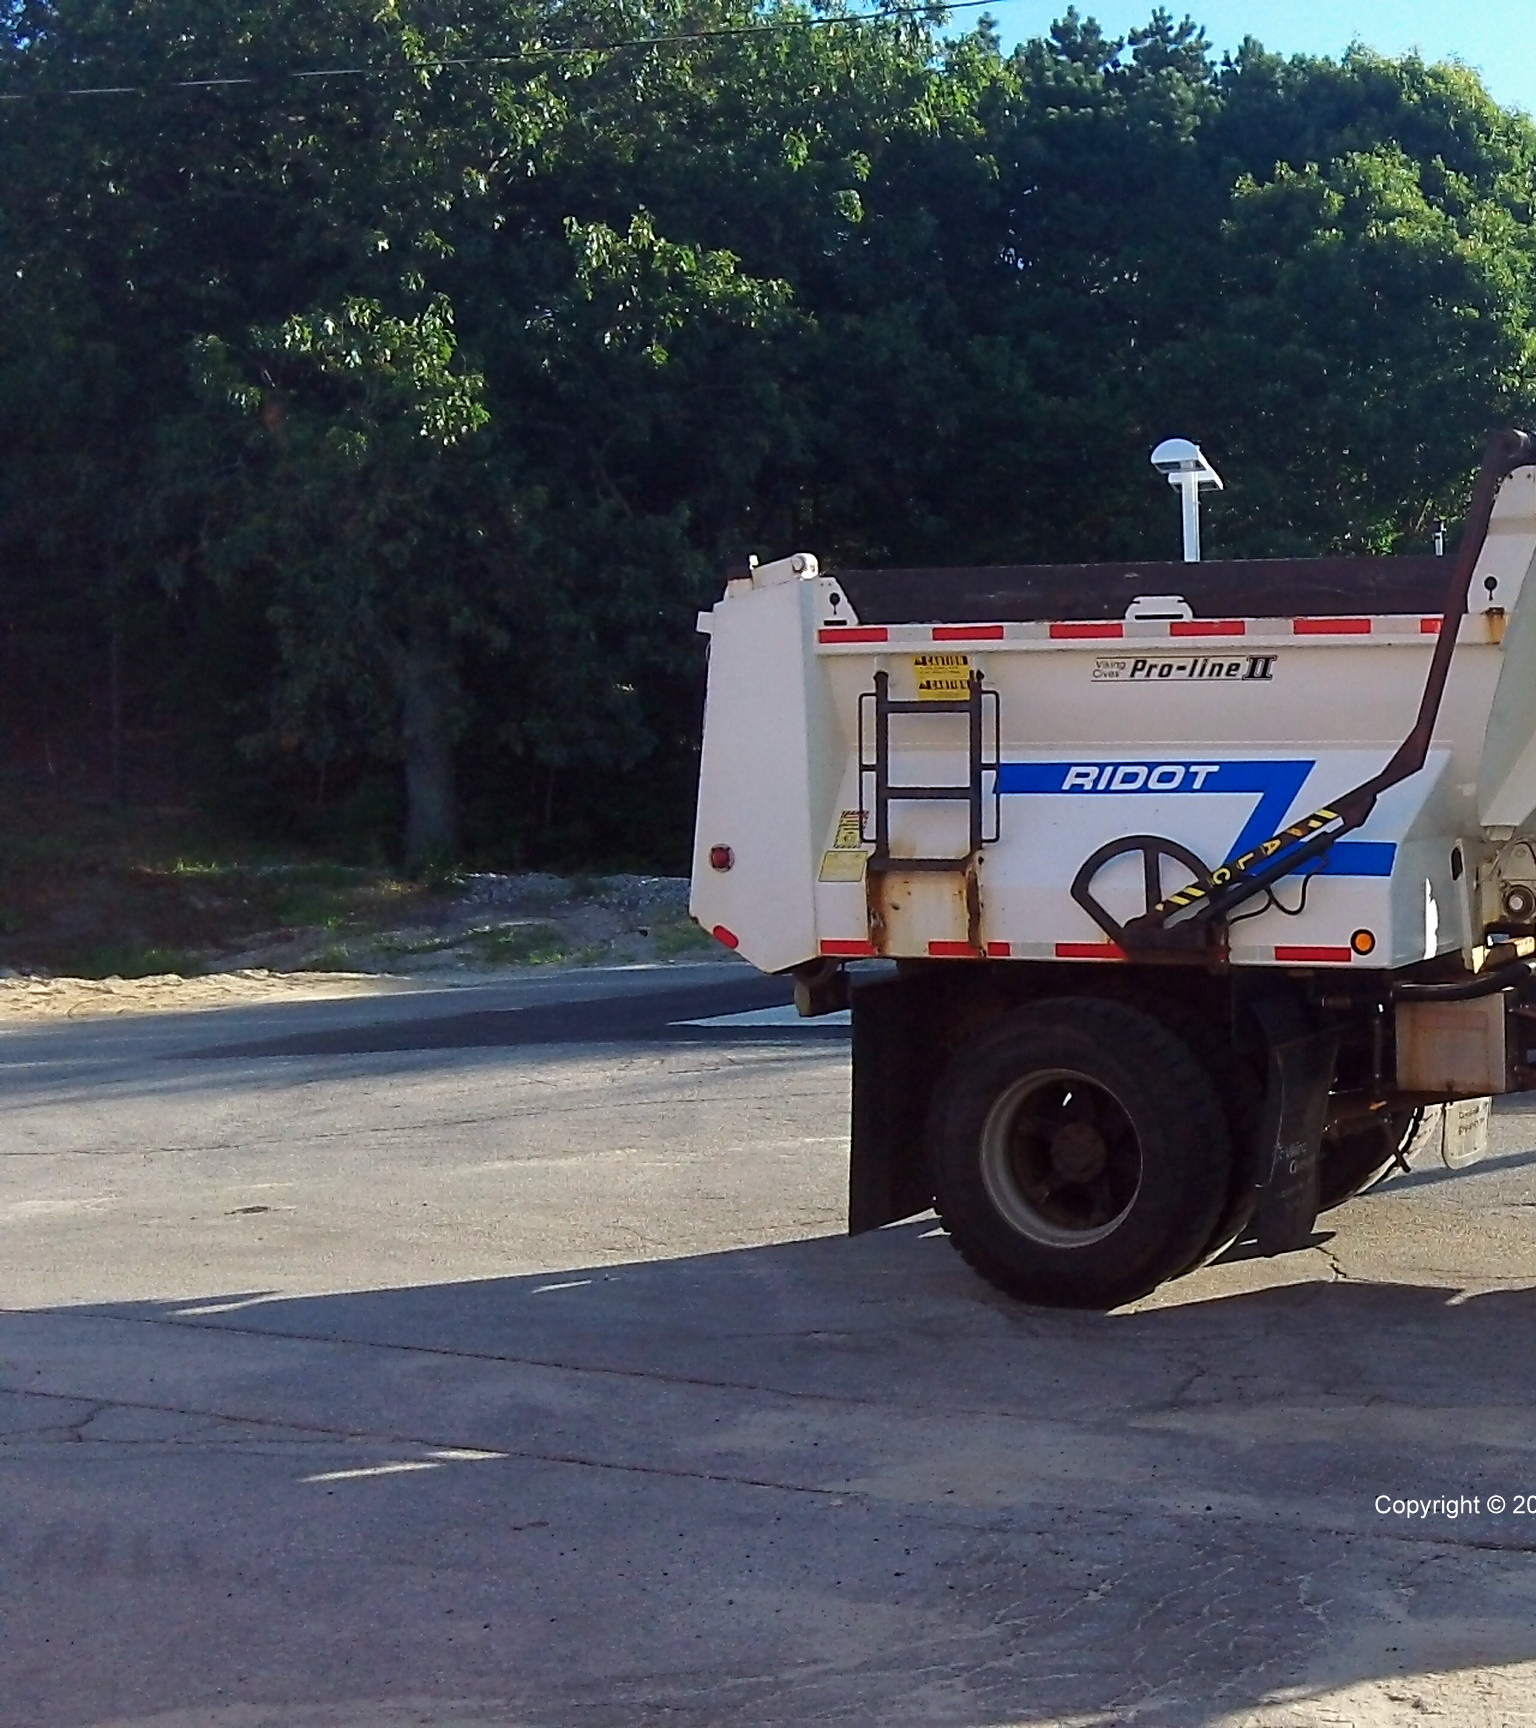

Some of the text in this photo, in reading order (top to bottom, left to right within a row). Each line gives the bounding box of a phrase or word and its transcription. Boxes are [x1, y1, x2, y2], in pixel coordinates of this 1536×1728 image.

[1129, 654, 1278, 681] Pro-line II
[1061, 765, 1220, 791] RIDOT
